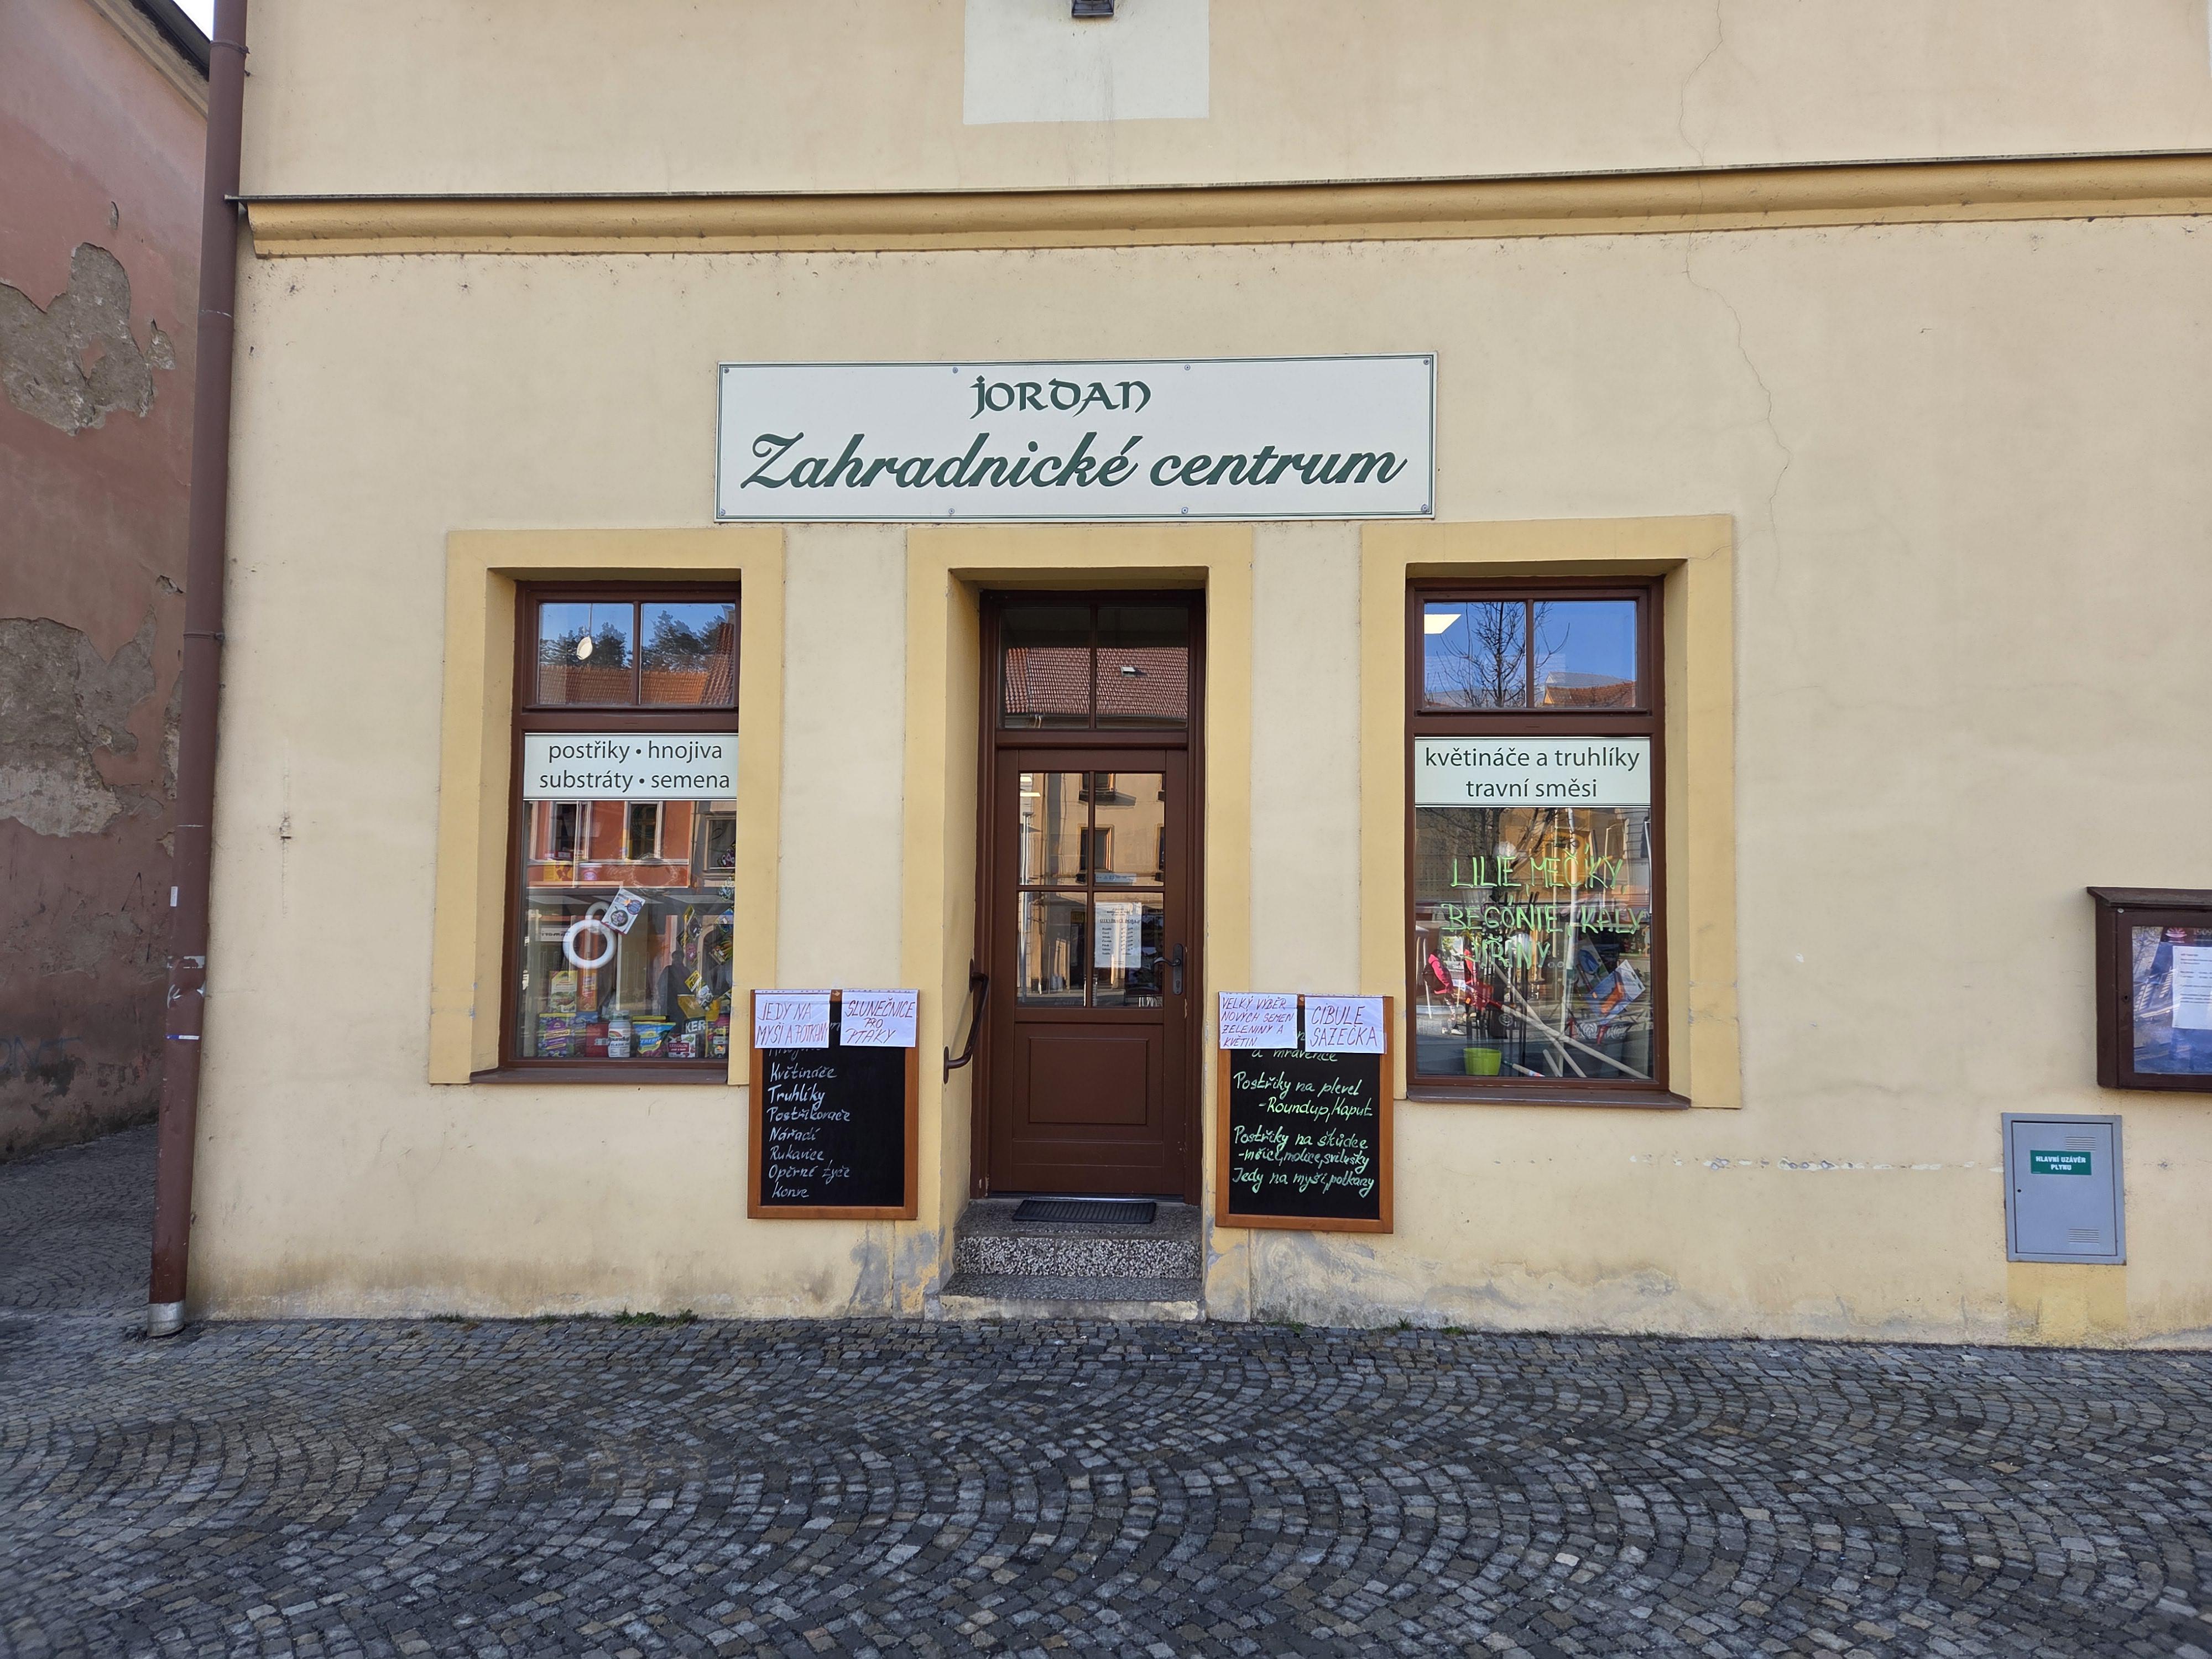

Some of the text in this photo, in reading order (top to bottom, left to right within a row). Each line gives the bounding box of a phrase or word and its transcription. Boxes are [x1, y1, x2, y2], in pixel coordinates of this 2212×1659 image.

[741, 431, 1408, 489] Zahradnické centrum
[549, 740, 722, 763] postřiky hnojiva
[1426, 747, 1640, 771] květináče a truhlíky
[540, 770, 729, 792] substráty semena
[1466, 779, 1597, 797] travní směsi
[757, 1002, 811, 1020] JEDY NA
[844, 997, 916, 1018] SLUNEČNICE
[1222, 995, 1287, 1010] VELKÝ VÝBĚR
[863, 1018, 883, 1029] PRO
[1221, 1009, 1295, 1022] NOVÝCH SEMEN
[1311, 1004, 1366, 1025] CIBULE
[785, 1024, 792, 1045] A
[1222, 1024, 1284, 1034] ZELENINY A
[1310, 1024, 1378, 1047] SAZEČKA
[770, 1062, 837, 1082] Květináče
[1233, 1071, 1363, 1100] Postřiky na plevel
[768, 1083, 825, 1111] Truhlíky
[769, 1126, 821, 1142] Nářadí
[1234, 1124, 1290, 1151] Postřiky
[1295, 1133, 1313, 1146] na
[770, 1144, 824, 1161] Rukavice
[769, 1164, 818, 1183] Opěrné
[1232, 1167, 1264, 1194] Jedy
[1269, 1171, 1288, 1185] na
[771, 1181, 810, 1198] Konve
